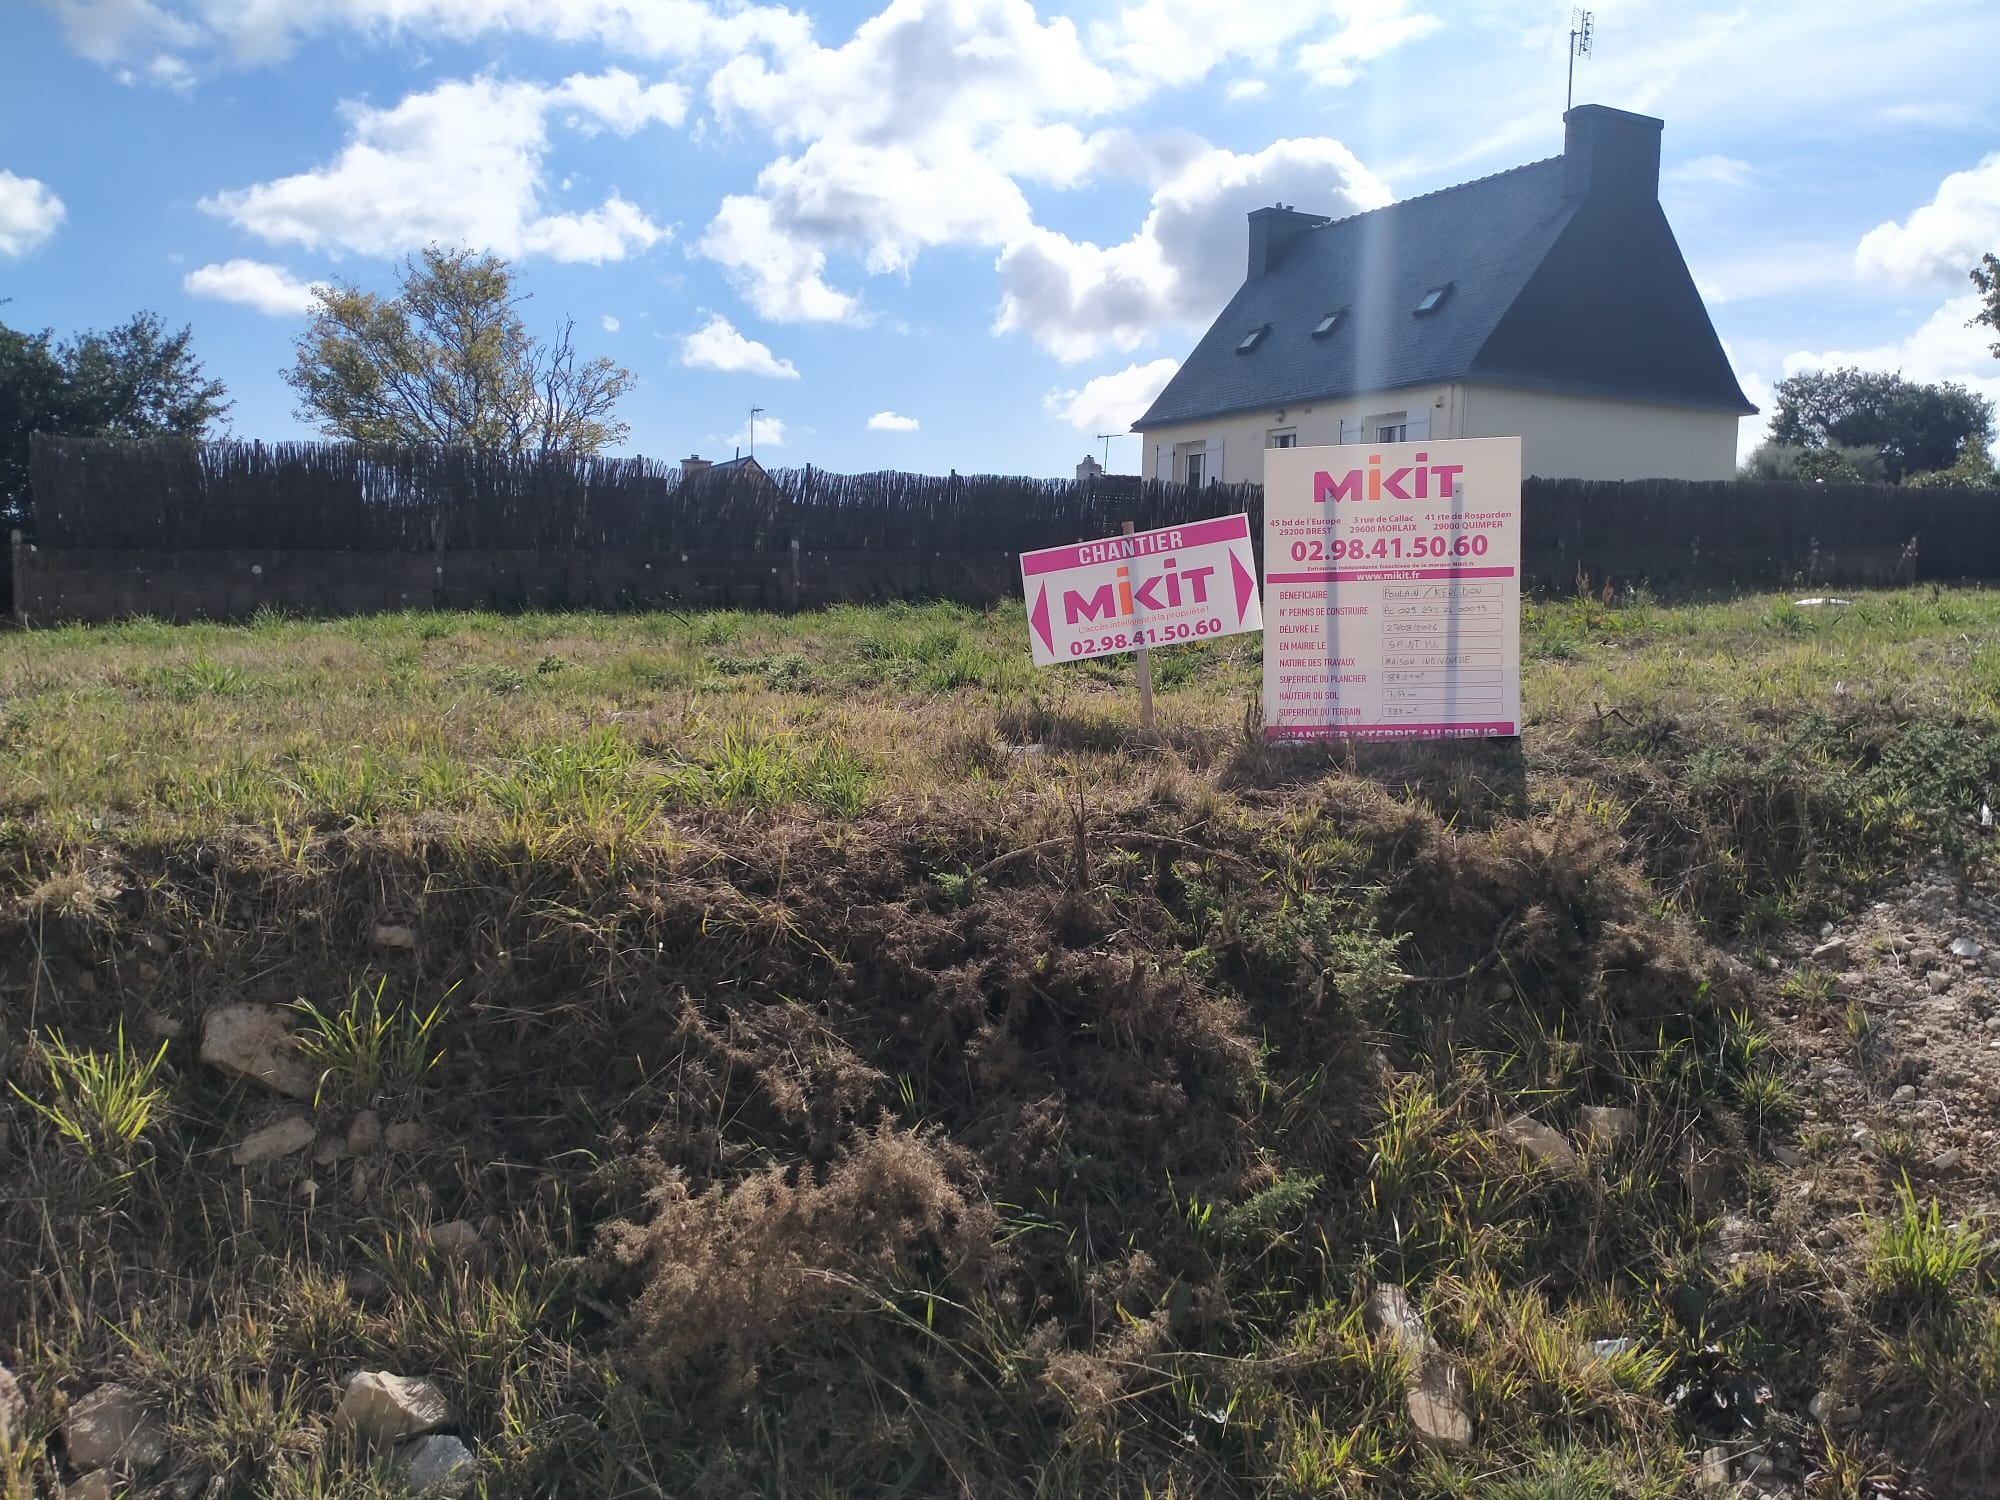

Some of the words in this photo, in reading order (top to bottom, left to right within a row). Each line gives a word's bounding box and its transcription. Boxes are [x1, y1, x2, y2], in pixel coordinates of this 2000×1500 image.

[1353, 516, 1359, 524] 3
[1360, 516, 1375, 524] rue
[1377, 514, 1387, 523] de
[1389, 514, 1414, 523] Callac
[1424, 513, 1435, 521] 41
[1437, 512, 1450, 521] rte
[1451, 511, 1463, 520] de
[1464, 510, 1512, 521] Rosporden
[1269, 519, 1280, 527] 45
[1282, 517, 1293, 526] bd
[1295, 517, 1305, 526] de
[1307, 517, 1341, 527] l'Europe
[1433, 522, 1460, 531] 29000
[1461, 520, 1503, 529] QUIMPER
[1279, 528, 1304, 536] 29200
[1306, 526, 1333, 535] BREST
[1350, 525, 1375, 534] 29600
[1377, 523, 1417, 533] MORLAIX
[1078, 530, 1183, 564] CHANTIER
[1291, 534, 1489, 562] 02.98.41.50.60
[1356, 571, 1421, 581] www.mikit.fr
[1288, 607, 1315, 617] PERMIS
[1315, 607, 1325, 616] DE
[1326, 606, 1369, 616] CONSTRUIRE
[1110, 617, 1150, 630] intelligent
[1151, 614, 1158, 622] à
[1157, 612, 1165, 621] la
[1310, 624, 1320, 633] LE
[1070, 618, 1222, 656] 02.98.41.50.60
[1279, 642, 1289, 651] EN
[1290, 641, 1316, 650] MAIRIE
[1317, 641, 1327, 650] LE
[1279, 658, 1306, 668] NATURE
[1307, 658, 1322, 667] DES
[1324, 657, 1356, 667] TRAVAUX
[1279, 674, 1318, 684] SUPERFICIE
[1319, 674, 1329, 683] DU
[1330, 674, 1367, 683] PLANCHER
[1279, 691, 1311, 701] HAUTEUR
[1312, 691, 1323, 700] DU
[1324, 691, 1339, 700] SOL
[1279, 707, 1319, 717] SUPERFICIE
[1320, 707, 1330, 716] DU
[1331, 707, 1361, 716] TERRAIN
